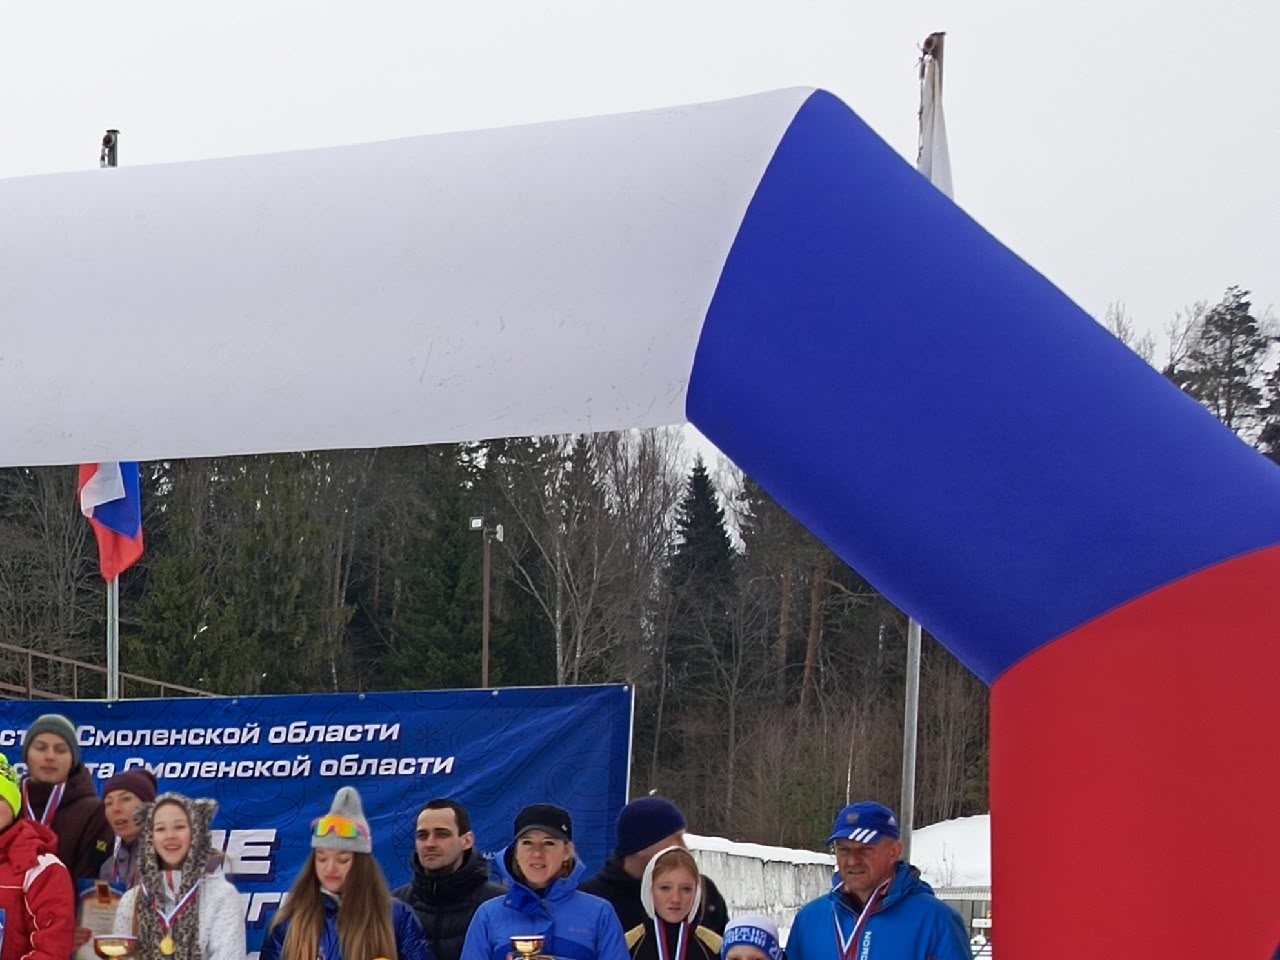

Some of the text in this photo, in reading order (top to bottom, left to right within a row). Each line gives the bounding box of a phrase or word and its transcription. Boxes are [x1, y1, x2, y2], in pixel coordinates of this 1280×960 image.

[76, 722, 261, 746] Смоленской
[267, 721, 401, 744] области
[319, 754, 455, 776] области
